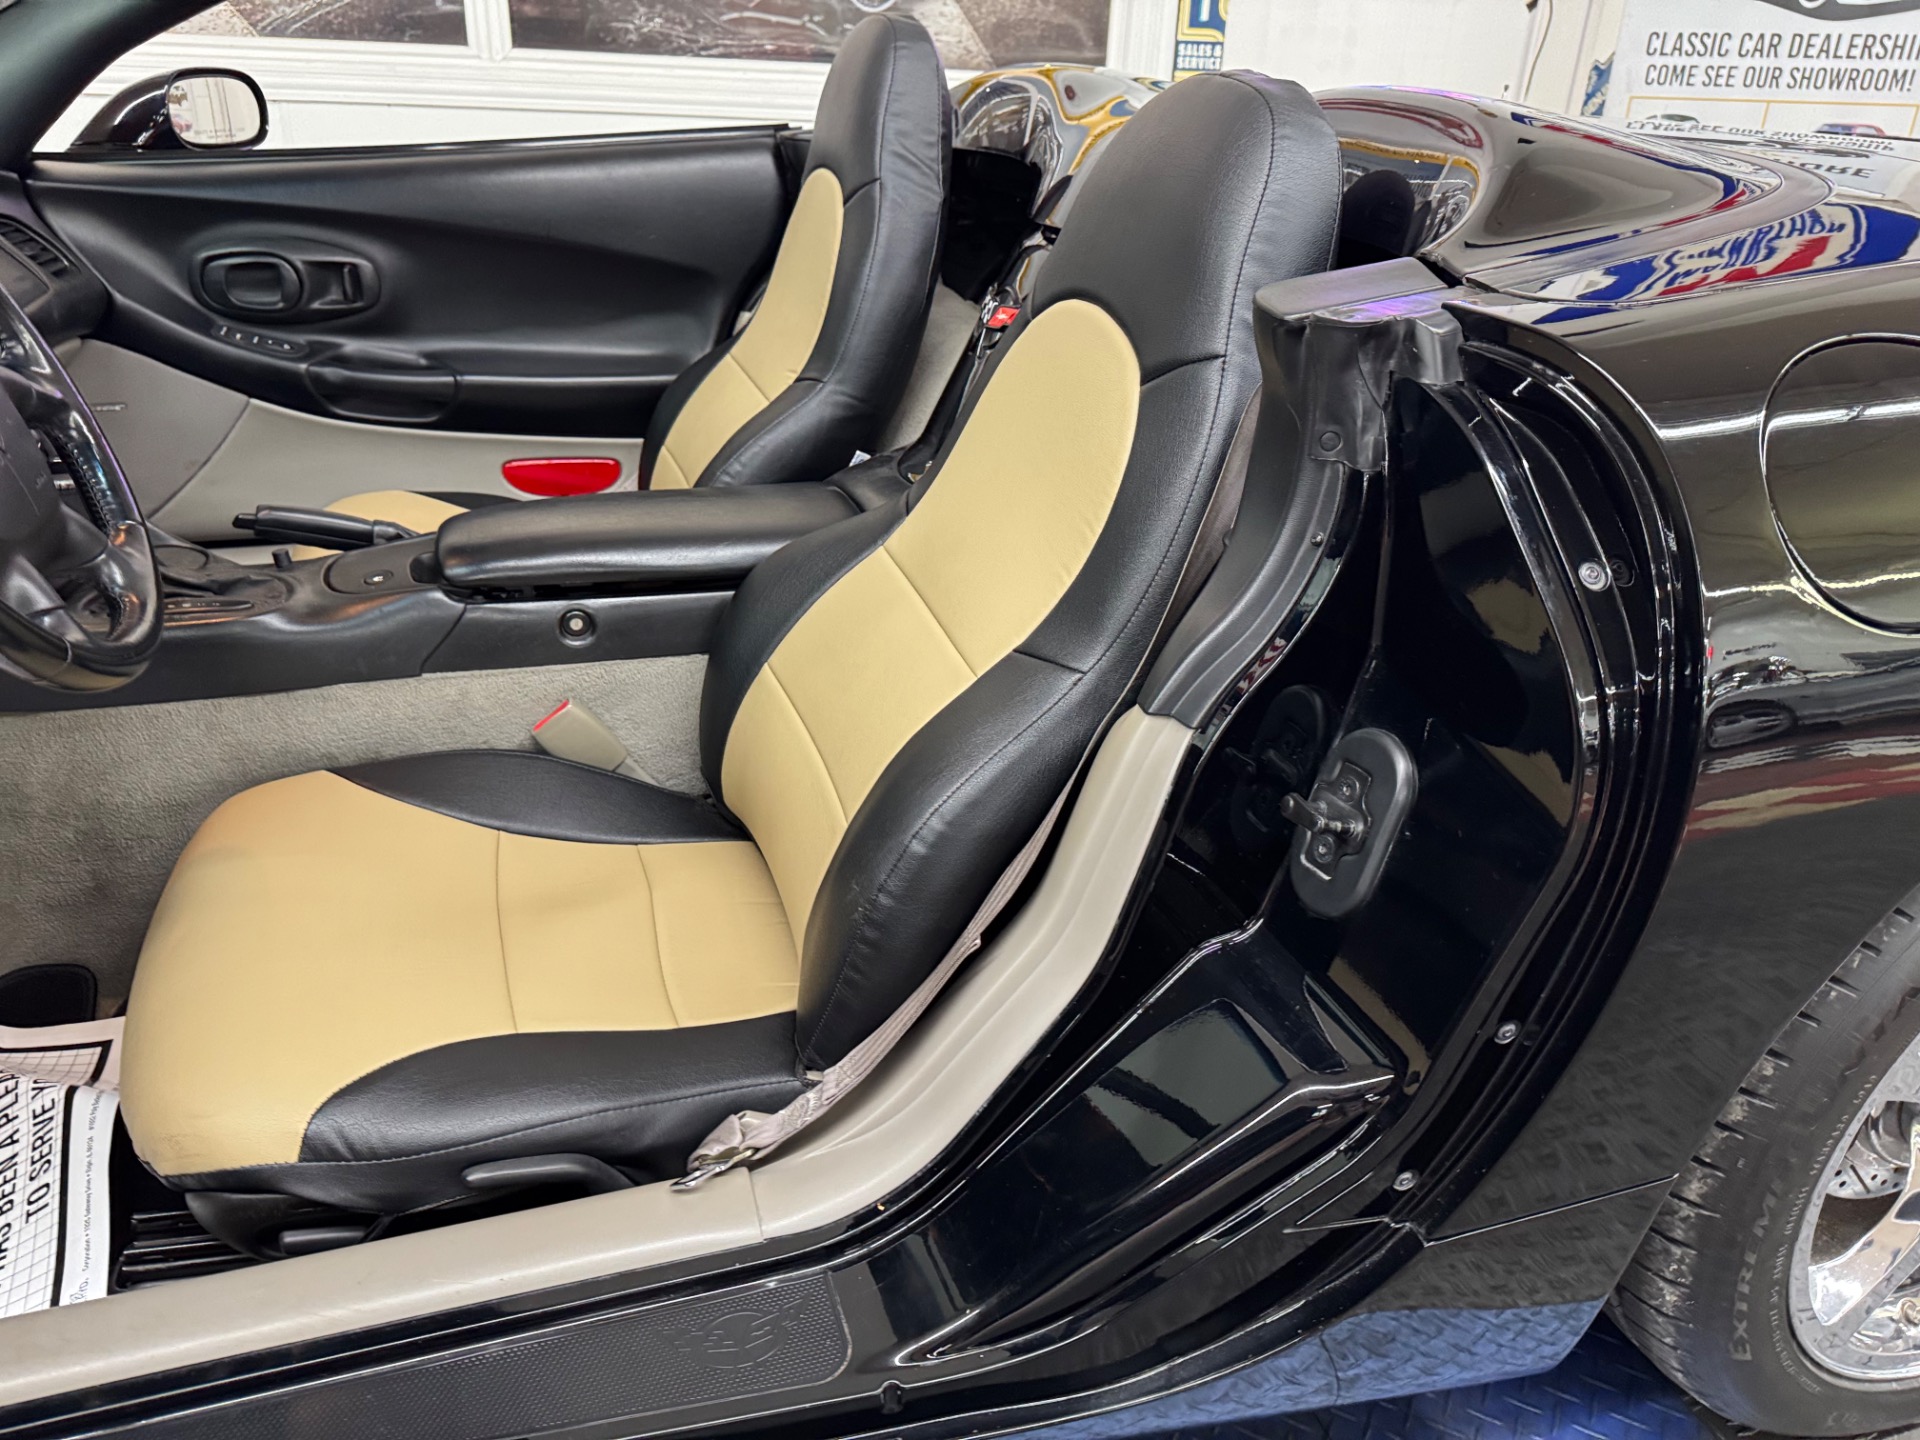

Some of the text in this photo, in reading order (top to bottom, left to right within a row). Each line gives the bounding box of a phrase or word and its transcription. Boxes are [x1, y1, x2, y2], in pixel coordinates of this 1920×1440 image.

[1178, 43, 1213, 57] SALES
[1646, 31, 1732, 58] CLASSIC
[1737, 32, 1782, 59] CAR
[1176, 56, 1221, 70] SERVICE
[1644, 64, 1917, 92] COME SEE OUR SHOWROOM!
[29, 1098, 56, 1182] SERVE
[25, 1183, 50, 1225] TO
